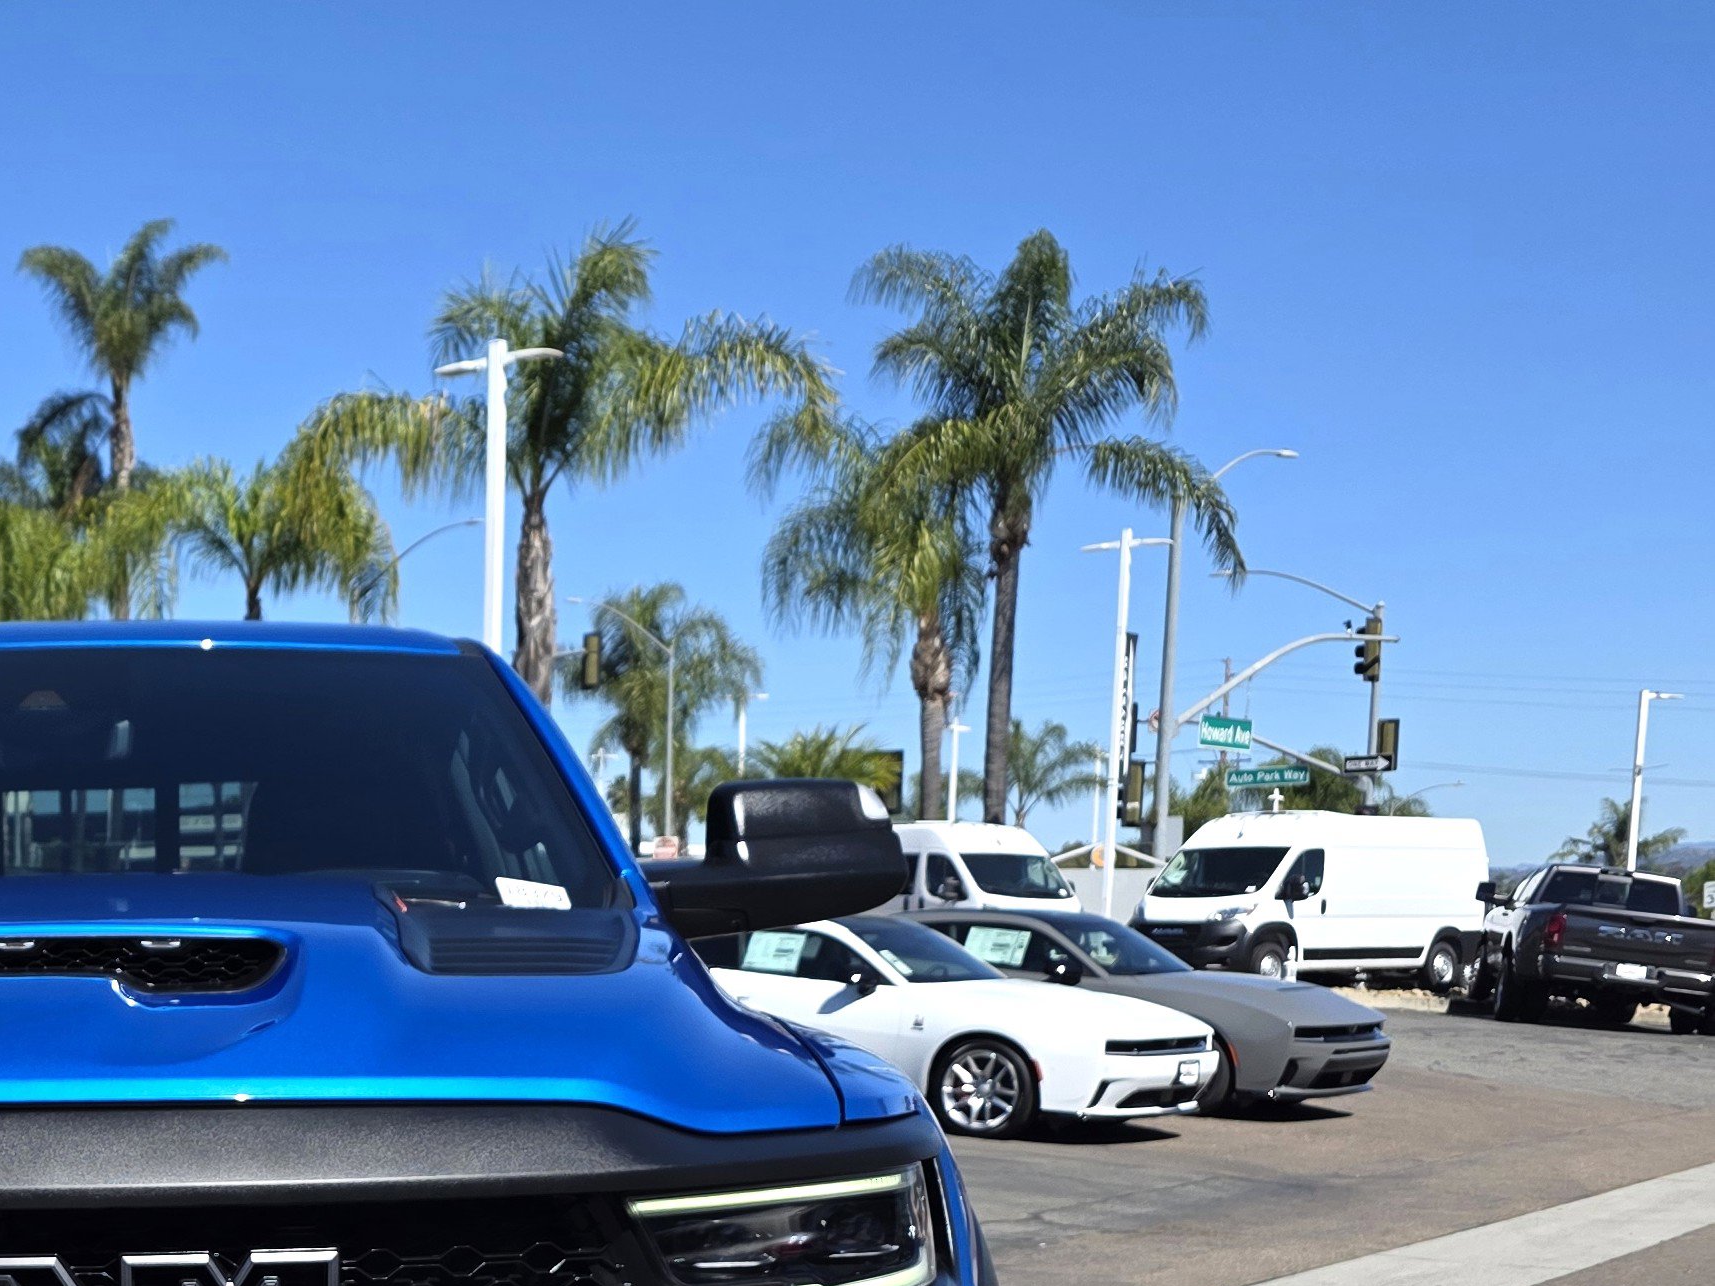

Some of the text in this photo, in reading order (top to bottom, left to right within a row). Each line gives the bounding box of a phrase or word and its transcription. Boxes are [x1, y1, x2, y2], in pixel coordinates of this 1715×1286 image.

[1201, 721, 1251, 745] Howard Ave
[1229, 769, 1305, 783] Auto Park Way
